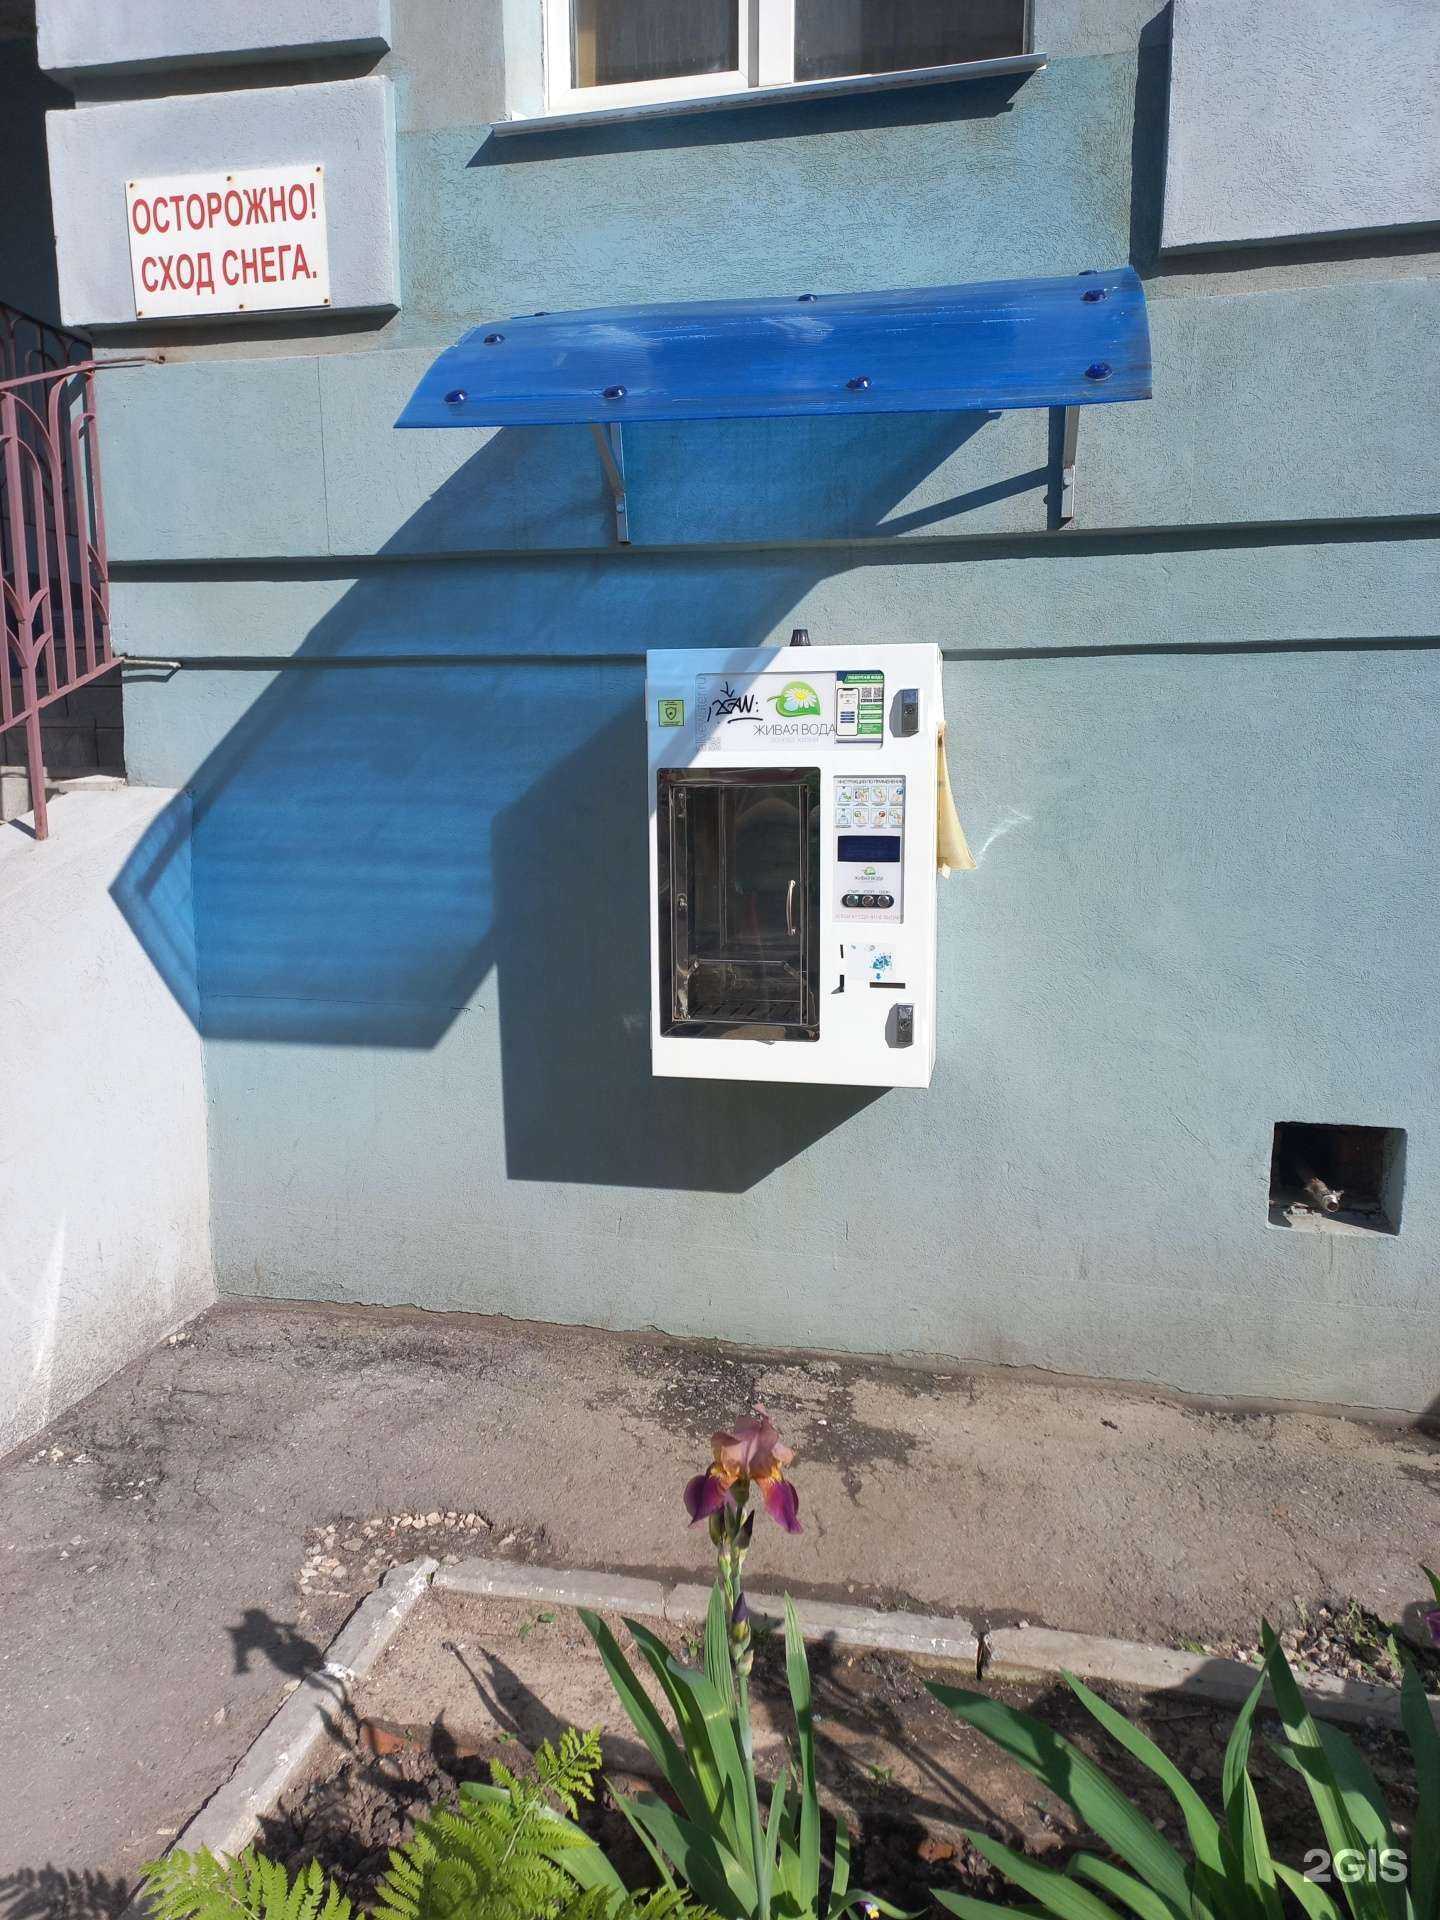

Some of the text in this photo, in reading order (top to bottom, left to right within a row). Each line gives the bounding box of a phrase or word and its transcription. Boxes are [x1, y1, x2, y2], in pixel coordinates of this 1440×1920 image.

[132, 183, 316, 235] ОСТОРОЖНО!
[141, 243, 317, 296] СХОД СНЕГА.
[753, 722, 835, 737] ЖИВАЯ ВОДА
